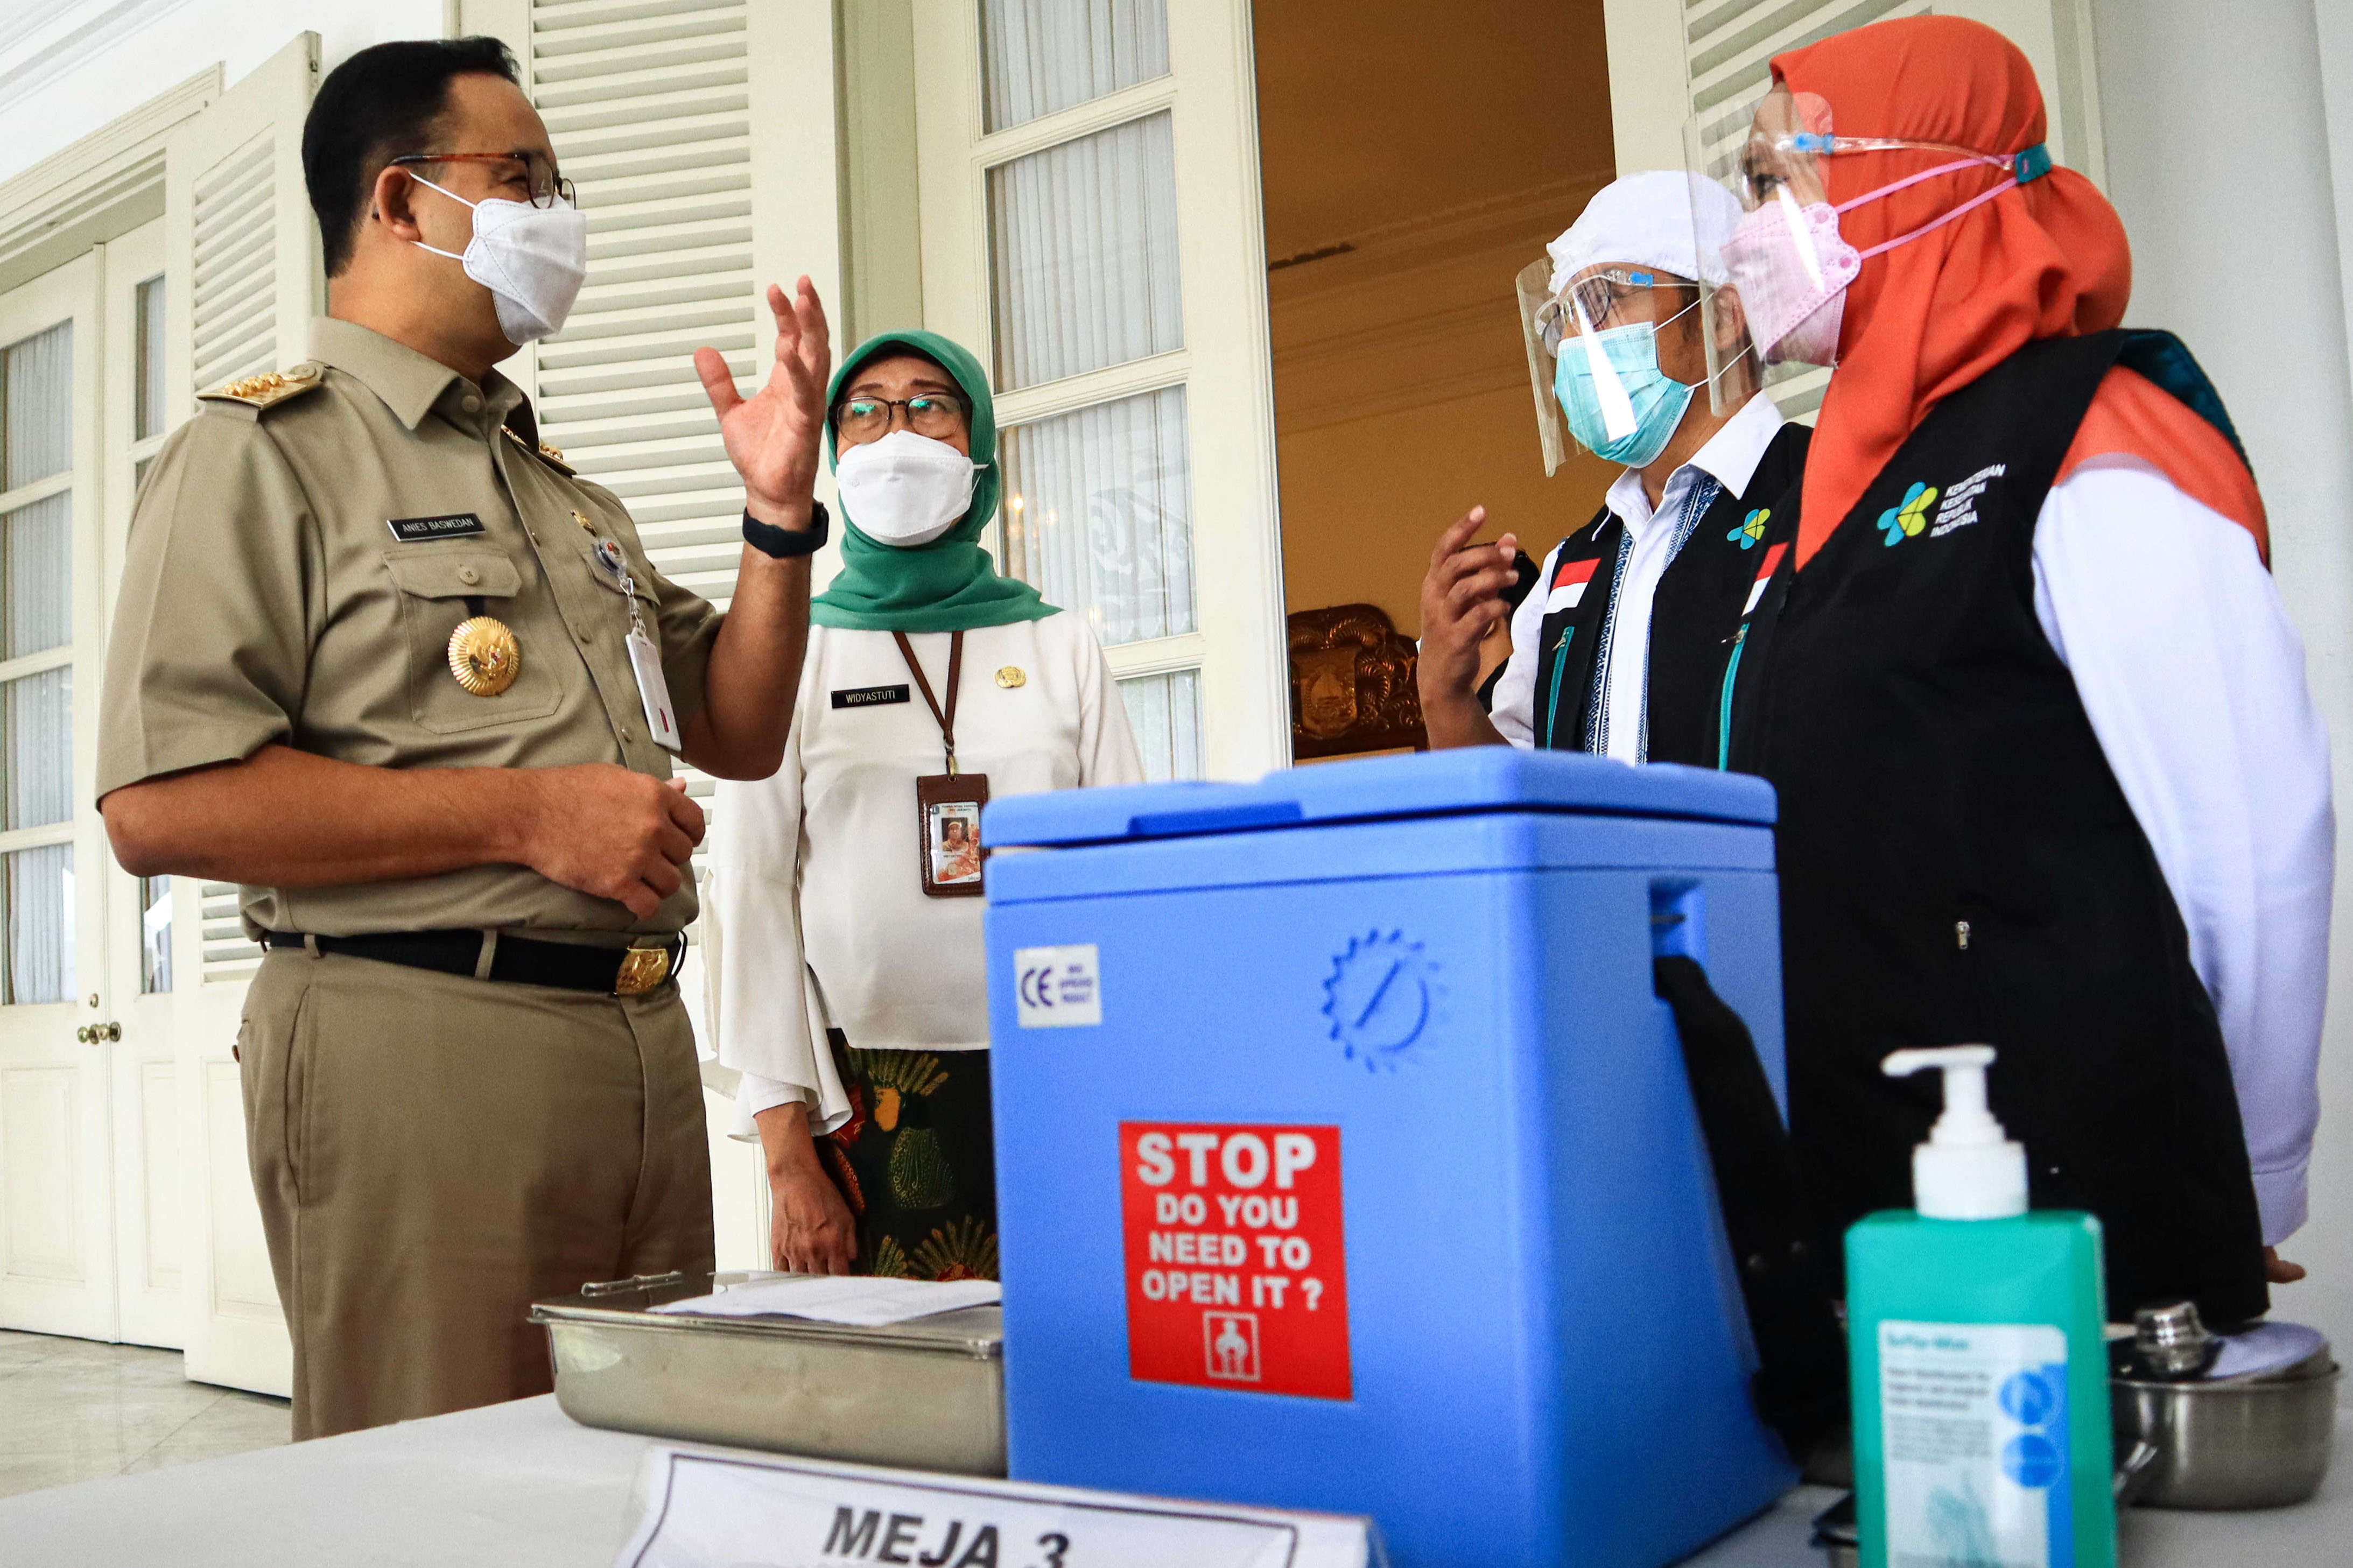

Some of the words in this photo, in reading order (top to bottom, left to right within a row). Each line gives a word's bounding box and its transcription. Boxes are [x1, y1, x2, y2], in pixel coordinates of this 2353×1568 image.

[402, 522, 428, 532] ANIES
[428, 518, 474, 530] BASWEDAN
[845, 690, 895, 704] WIDYASTUTI
[1021, 966, 1053, 1008] CE
[1136, 1131, 1317, 1190] STOP
[1155, 1192, 1207, 1226] DO
[1216, 1194, 1299, 1230] YOU
[1148, 1231, 1247, 1267] NEED
[1255, 1235, 1311, 1271] TO
[1141, 1269, 1240, 1305] OPEN
[1251, 1275, 1290, 1310] IT
[821, 1506, 1000, 1568] MEJA
[1024, 1532, 1070, 1568] 3
